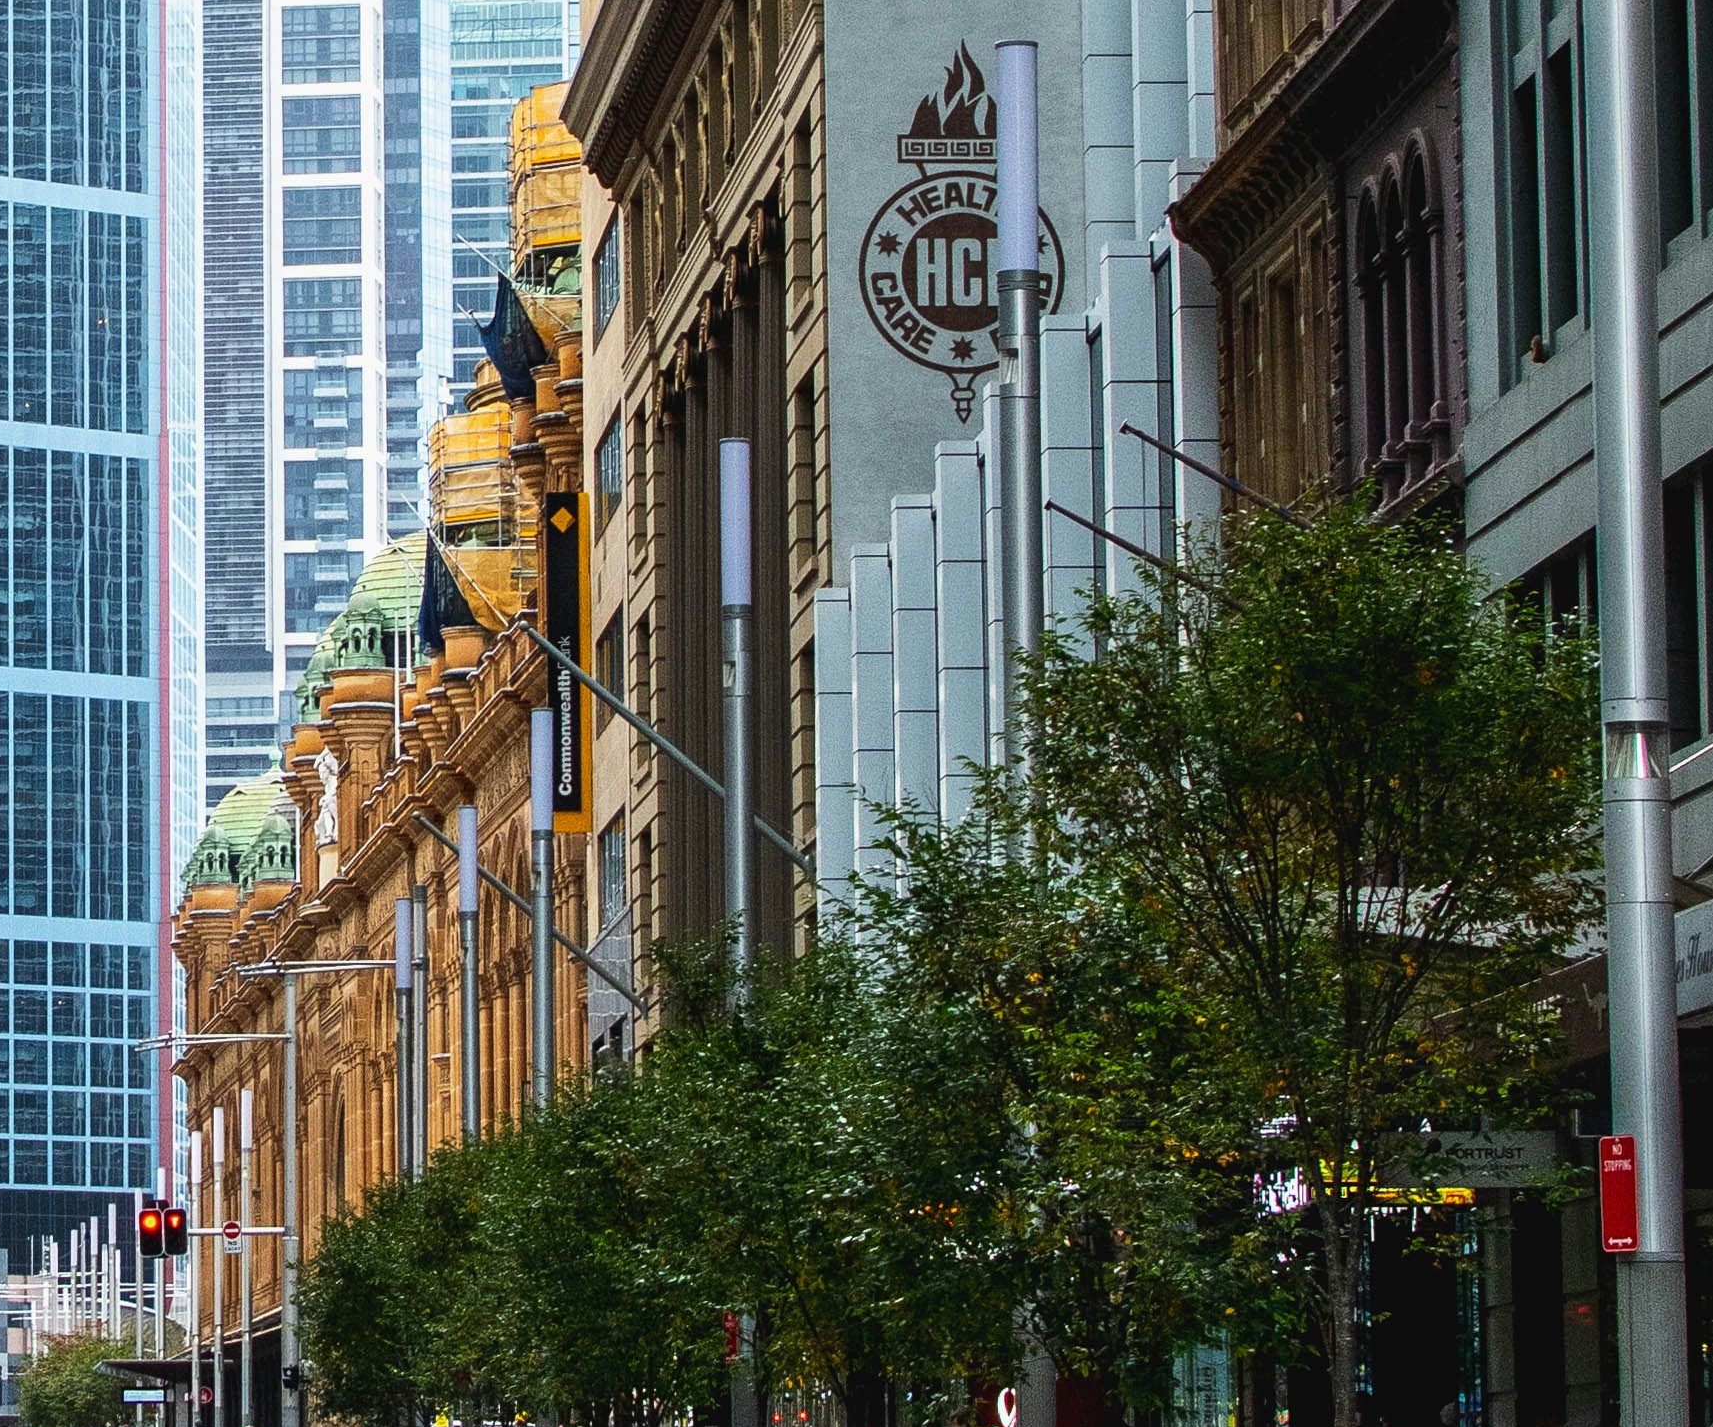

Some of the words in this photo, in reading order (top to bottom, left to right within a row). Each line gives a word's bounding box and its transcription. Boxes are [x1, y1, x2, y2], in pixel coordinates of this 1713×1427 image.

[894, 181, 1000, 227] HEALT
[870, 270, 937, 355] CARE
[557, 670, 572, 797] Commonwealth
[1603, 1159, 1632, 1172] STOPPING
[1612, 1144, 1623, 1155] NO
